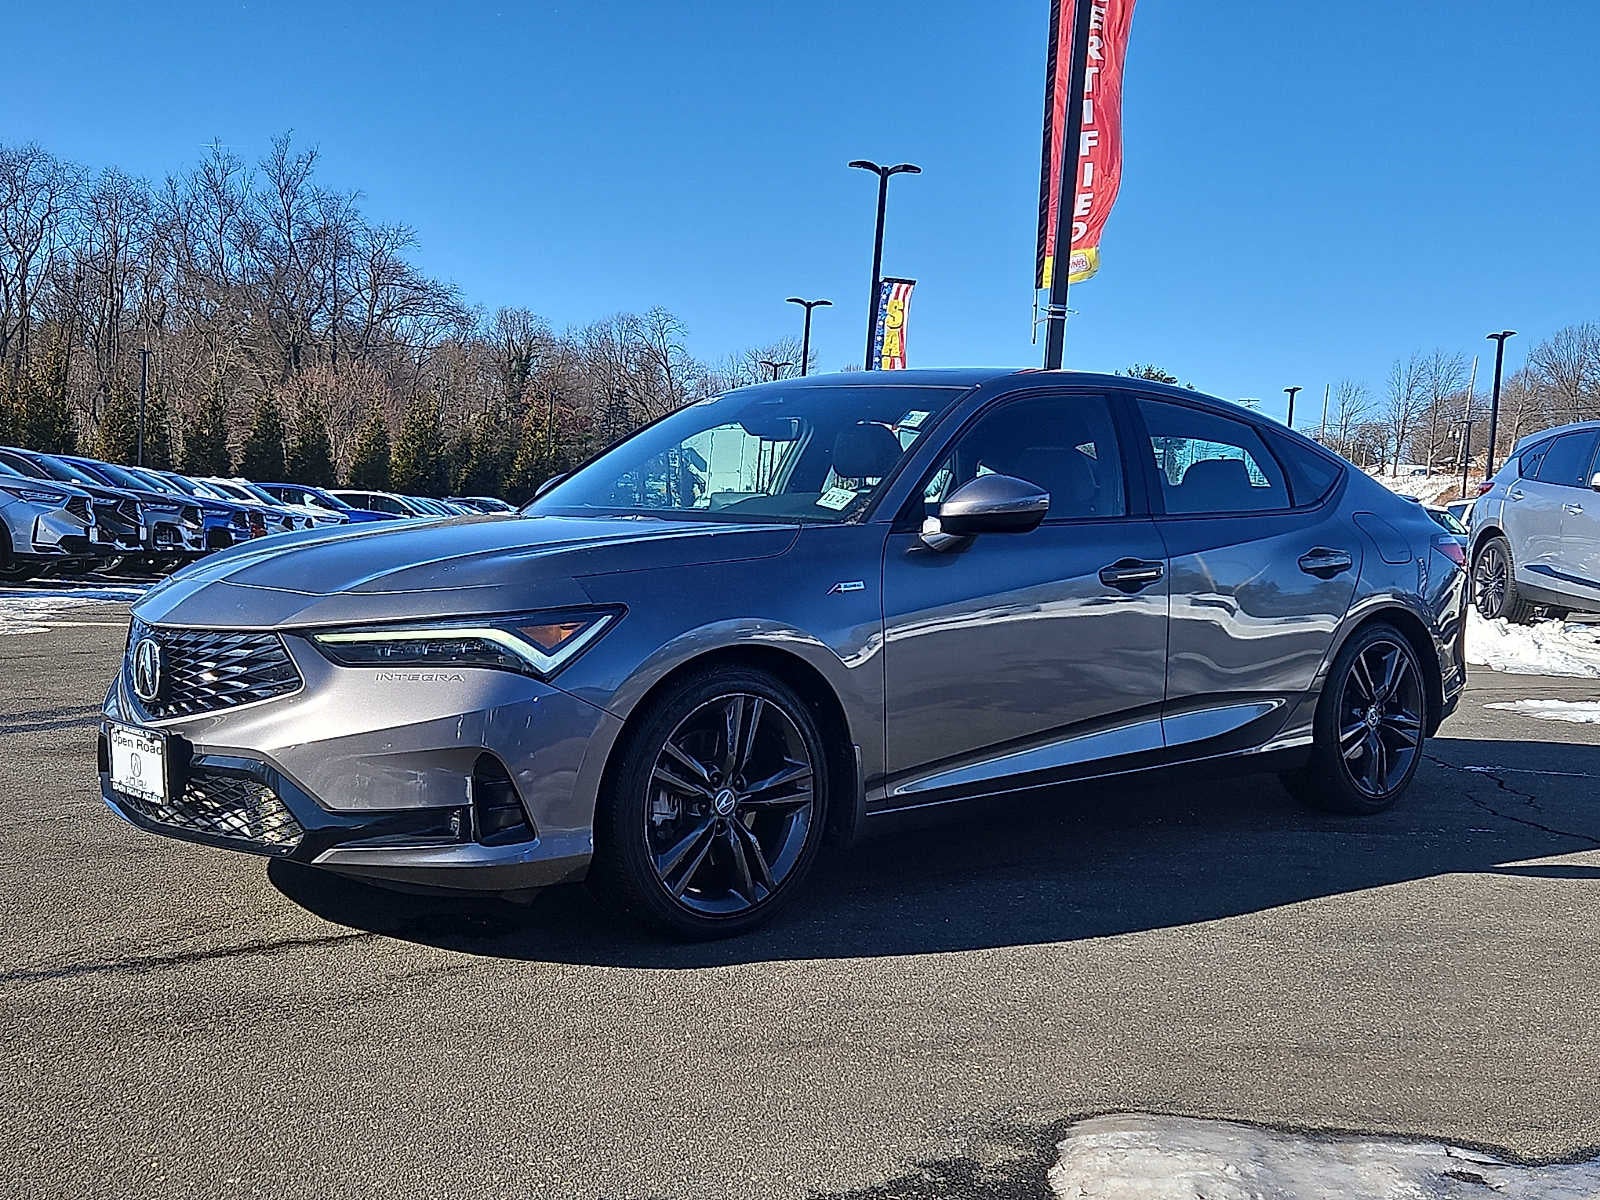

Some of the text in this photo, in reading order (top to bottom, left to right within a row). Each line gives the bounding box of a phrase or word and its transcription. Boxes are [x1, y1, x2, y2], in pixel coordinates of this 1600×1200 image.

[1071, 0, 1109, 243] ERTIFIED
[375, 673, 465, 682] INTEGRA
[112, 731, 134, 748] Open
